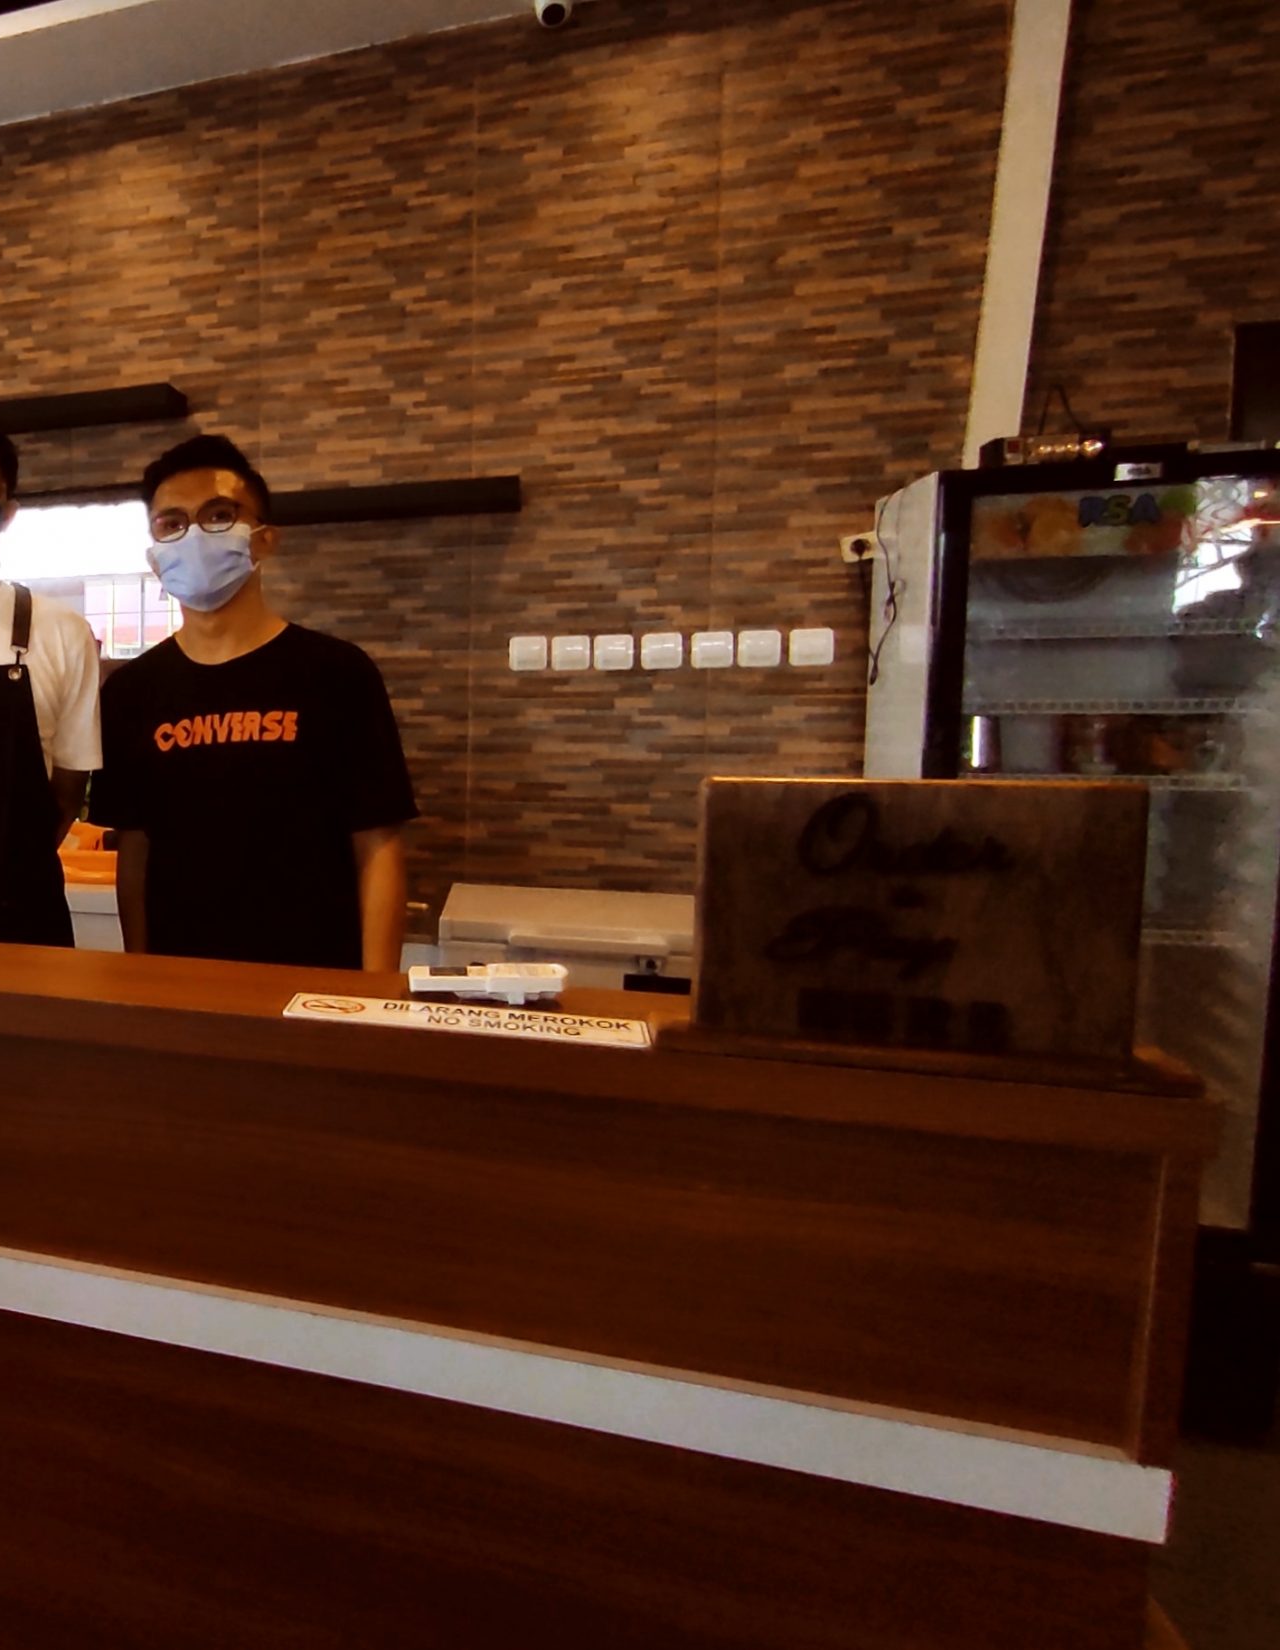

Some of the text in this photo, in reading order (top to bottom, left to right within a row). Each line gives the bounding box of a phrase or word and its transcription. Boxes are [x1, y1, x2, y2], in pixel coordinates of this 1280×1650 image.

[154, 711, 298, 751] CONVERSE
[382, 1002, 632, 1031] DILARANG MEROKOK
[427, 1015, 582, 1036] NO SMOKING
